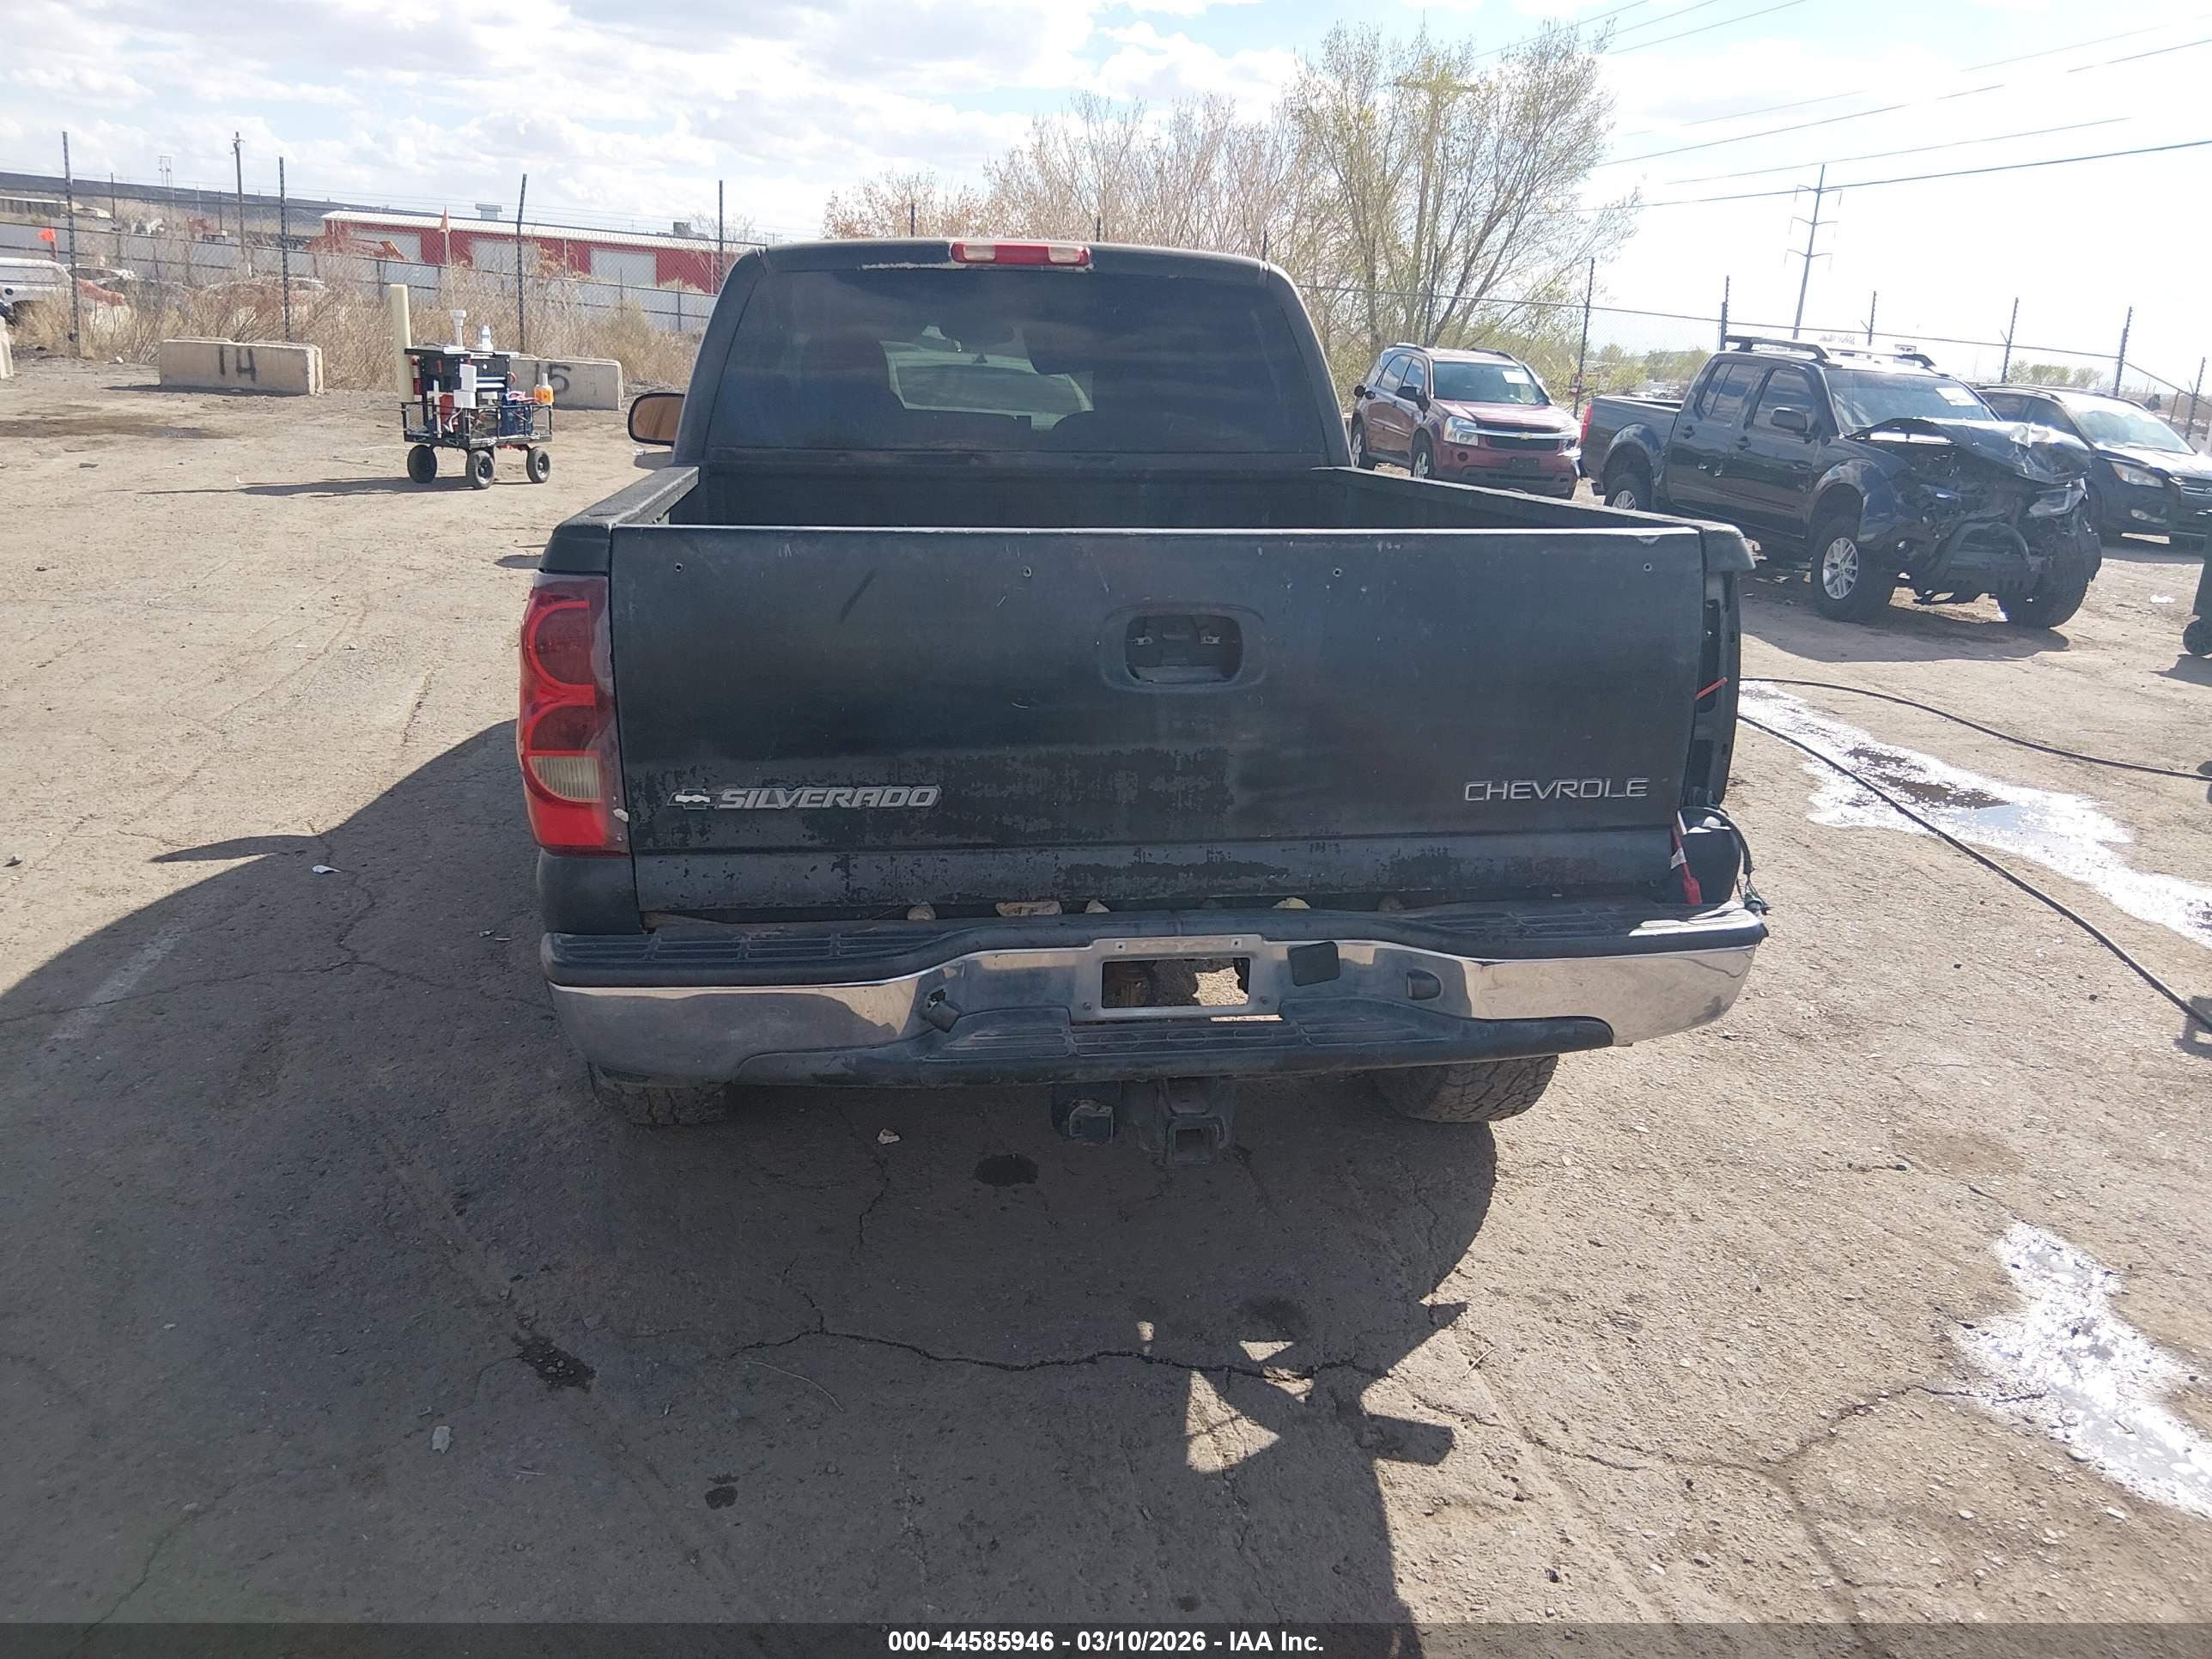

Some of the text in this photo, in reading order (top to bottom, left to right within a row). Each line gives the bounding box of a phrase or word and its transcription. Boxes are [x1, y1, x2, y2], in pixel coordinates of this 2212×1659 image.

[218, 345, 256, 382] 14
[535, 362, 572, 393] 15
[717, 787, 939, 809] SILVERADO
[1464, 778, 1649, 801] CHEVROLE
